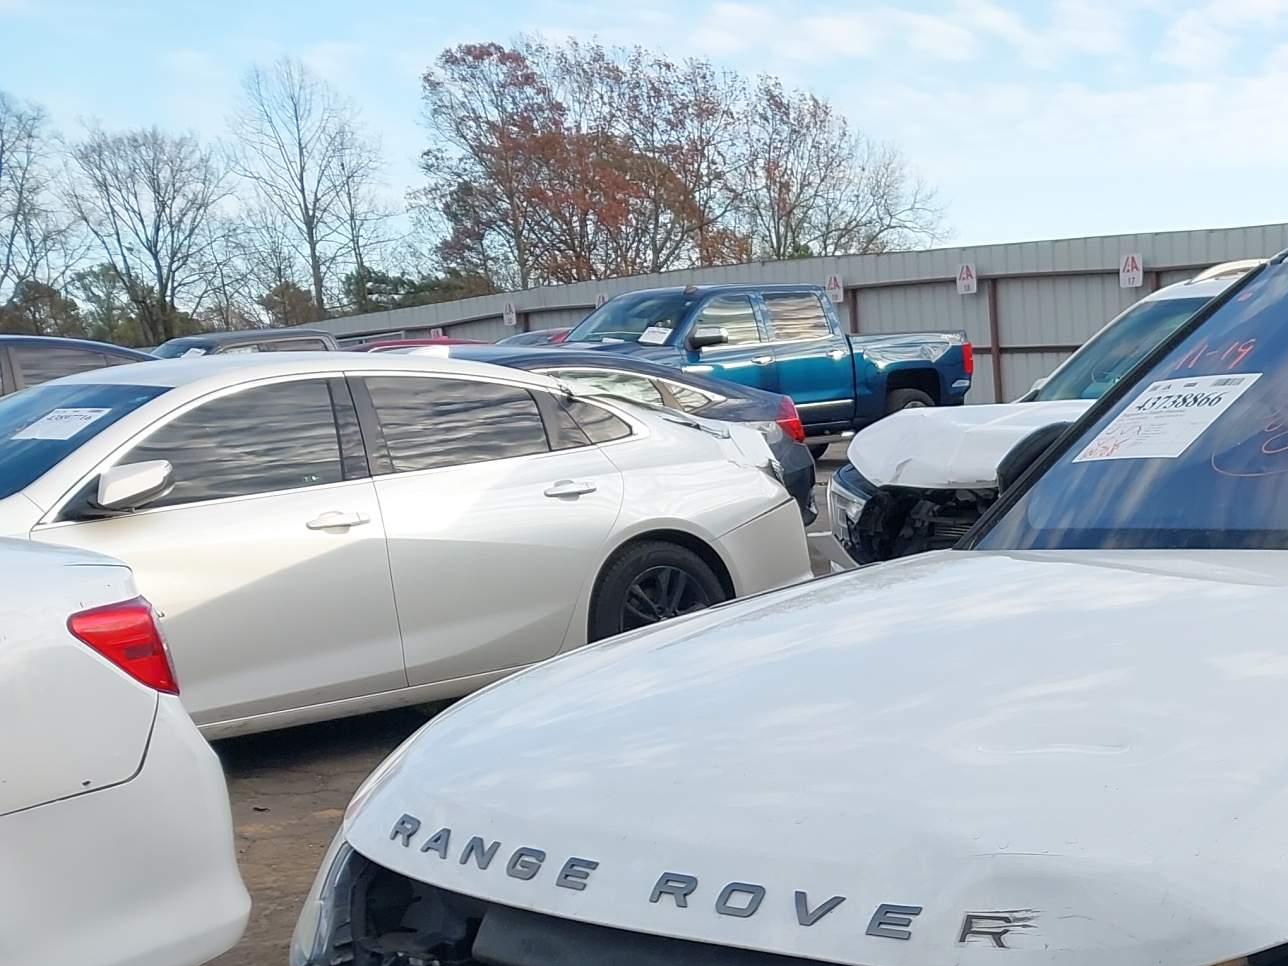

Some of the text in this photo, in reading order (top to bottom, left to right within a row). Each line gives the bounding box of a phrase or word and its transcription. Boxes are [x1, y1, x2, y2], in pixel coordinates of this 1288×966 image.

[1136, 391, 1228, 412] 43738866
[389, 813, 1026, 949] RANGE ROVER
